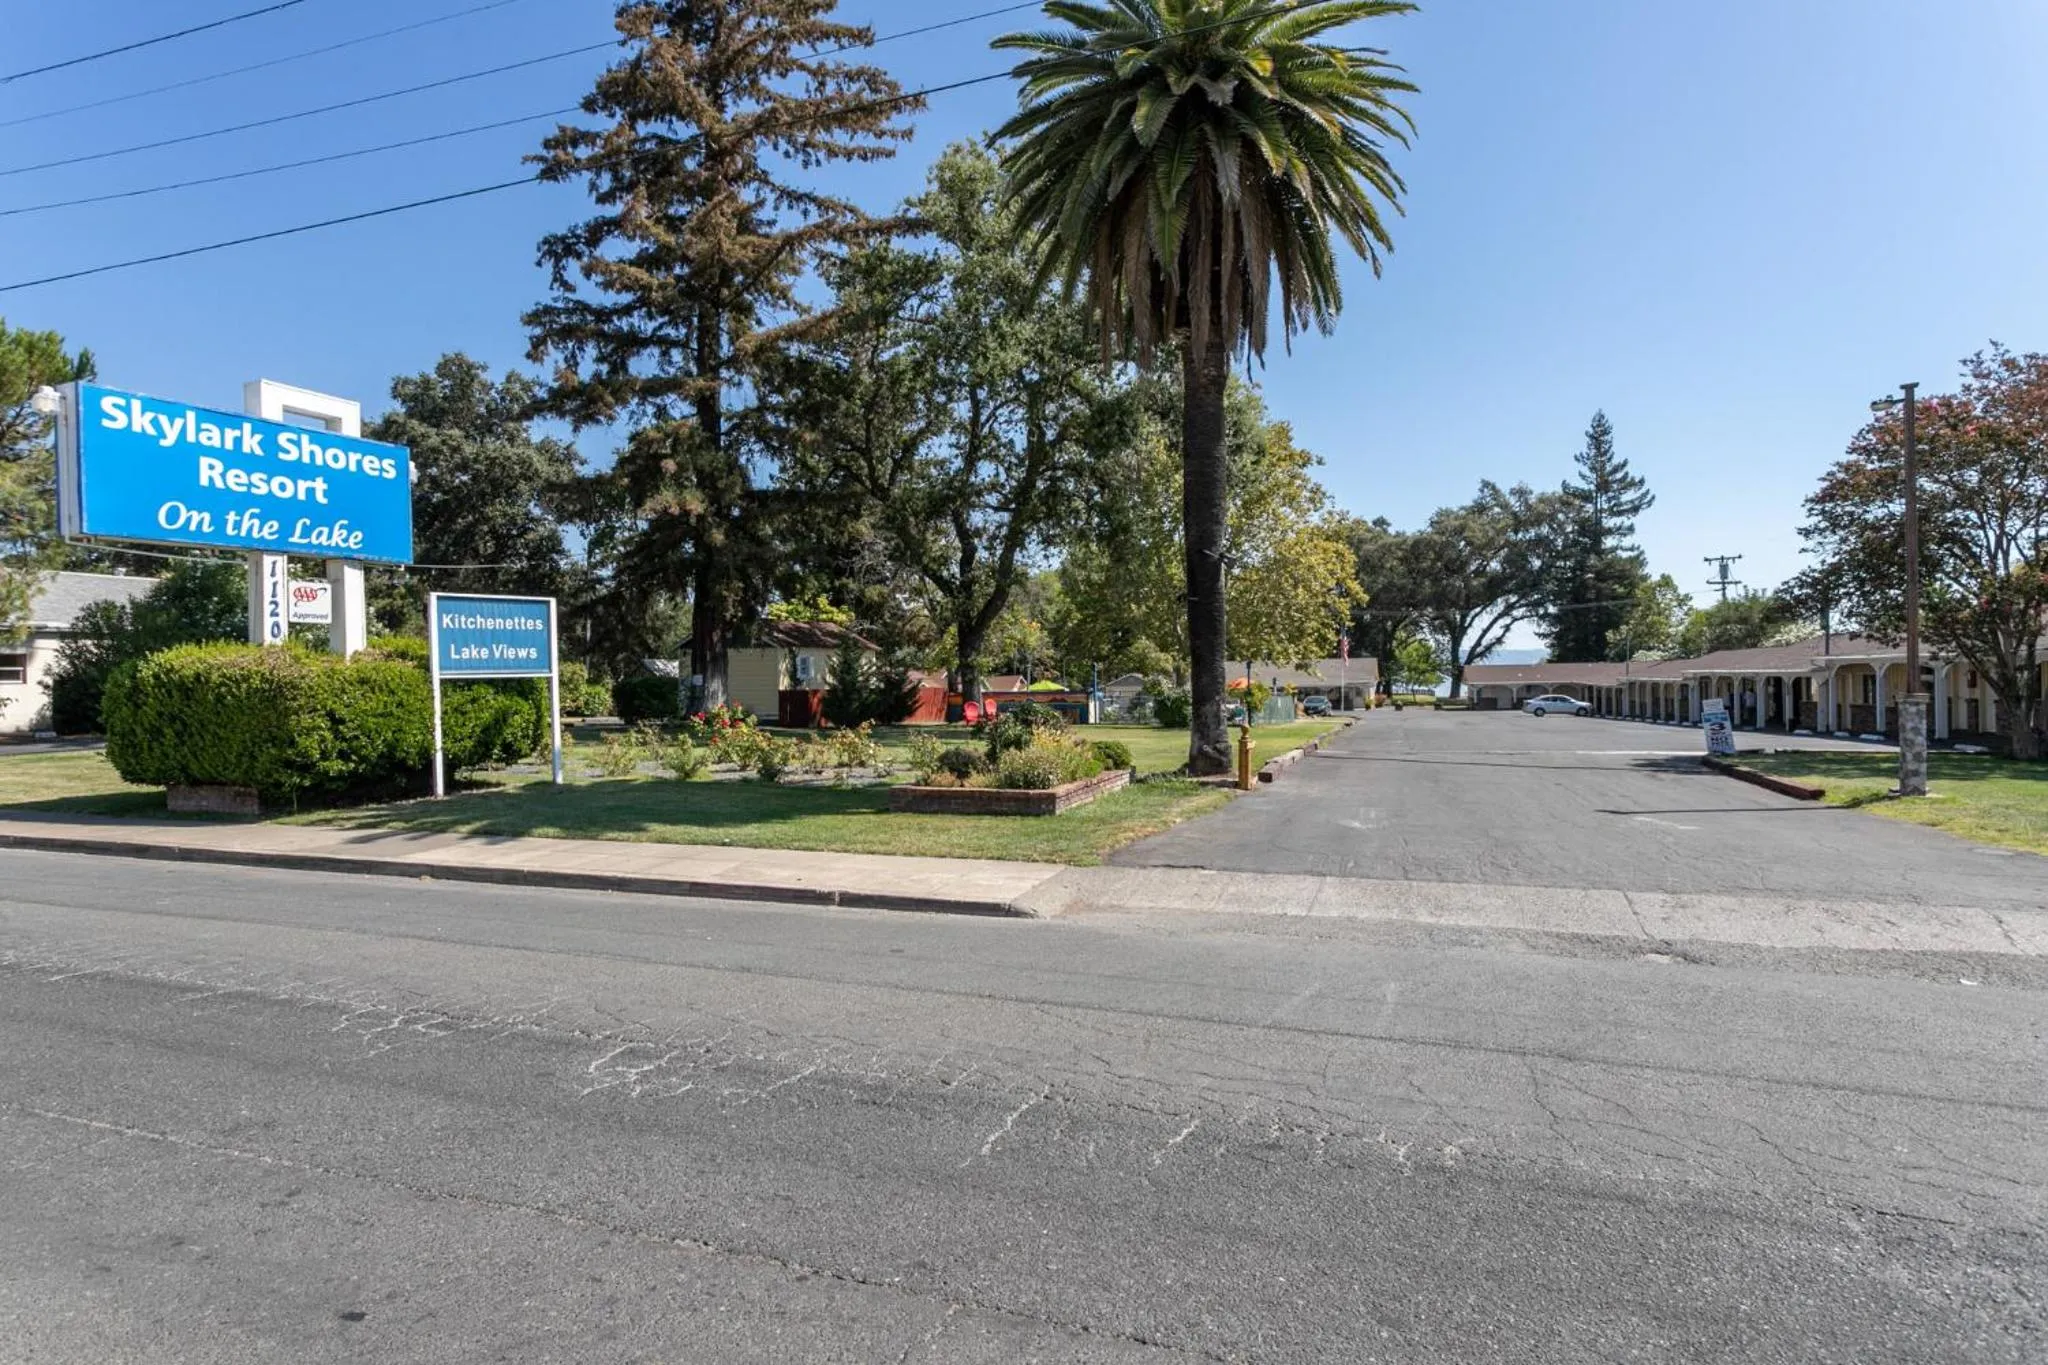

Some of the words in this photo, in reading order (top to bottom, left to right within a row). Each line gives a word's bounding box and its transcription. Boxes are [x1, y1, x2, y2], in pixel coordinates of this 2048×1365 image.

[100, 395, 264, 456] Skylark
[277, 431, 397, 479] Shores
[199, 456, 328, 504] Resort
[158, 501, 215, 533] On
[224, 508, 279, 540] the
[288, 518, 363, 549] Lake
[269, 560, 281, 638] 1120
[293, 587, 318, 602] AAA
[292, 611, 329, 620] Approved
[442, 613, 544, 630] Kitchenettes
[450, 643, 489, 659] Lake
[492, 643, 538, 659] Views
